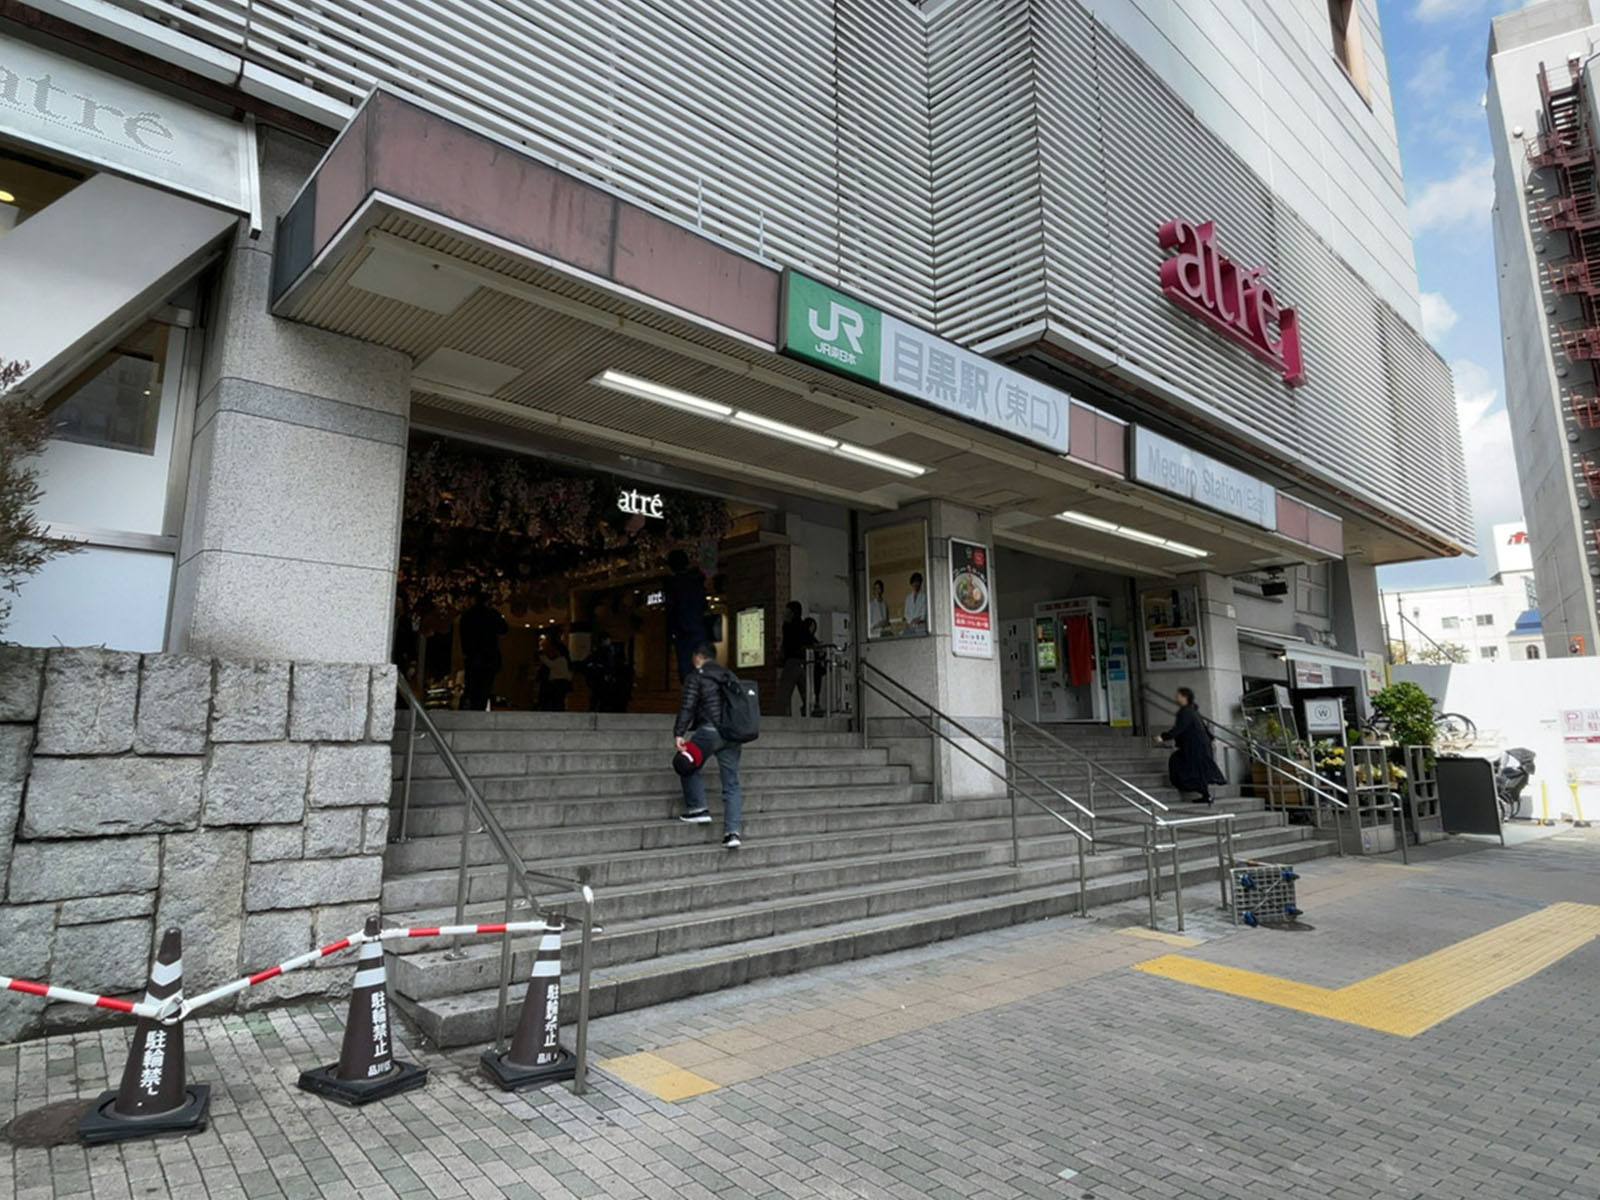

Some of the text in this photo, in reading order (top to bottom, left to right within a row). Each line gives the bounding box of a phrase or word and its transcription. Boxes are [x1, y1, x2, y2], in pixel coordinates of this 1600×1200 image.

[808, 301, 864, 355] JR
[617, 489, 664, 519] atré
[1148, 446, 1198, 489] Meguro
[1202, 468, 1242, 507] Station
[371, 990, 388, 1058] 駐輪禁止
